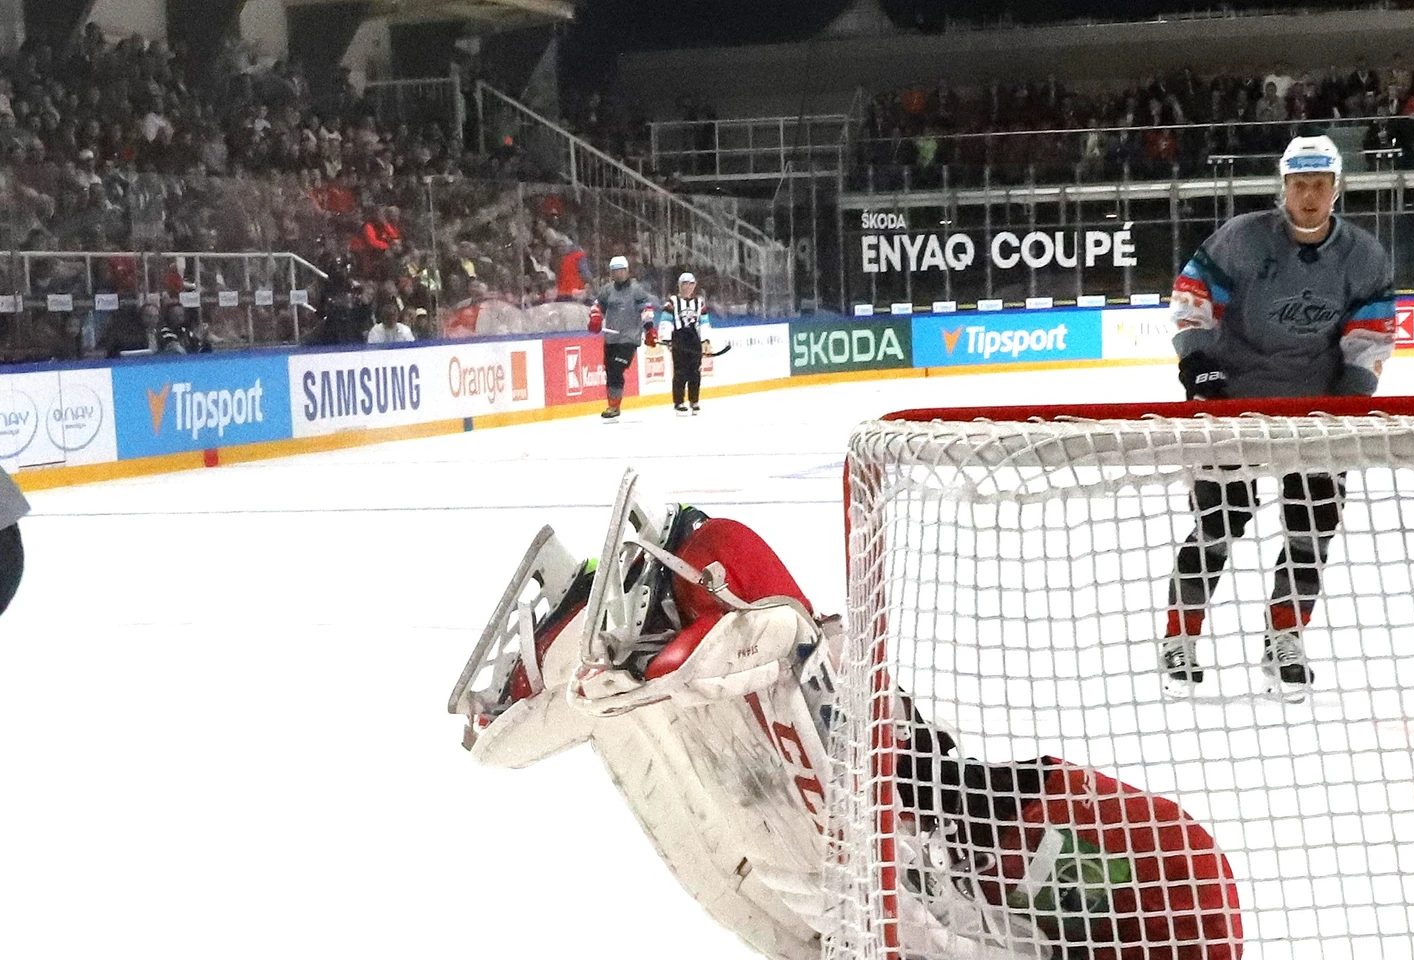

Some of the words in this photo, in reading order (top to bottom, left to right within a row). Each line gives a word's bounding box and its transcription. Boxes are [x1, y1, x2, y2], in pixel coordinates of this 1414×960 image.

[861, 209, 907, 230] ŠKODA
[862, 233, 975, 273] ENYAQ
[991, 222, 1138, 269] COUPÉ
[965, 323, 1068, 359] Tipsport
[302, 363, 421, 422] SAMSUNG
[448, 356, 505, 404] Orange
[172, 378, 263, 441] Tipsport
